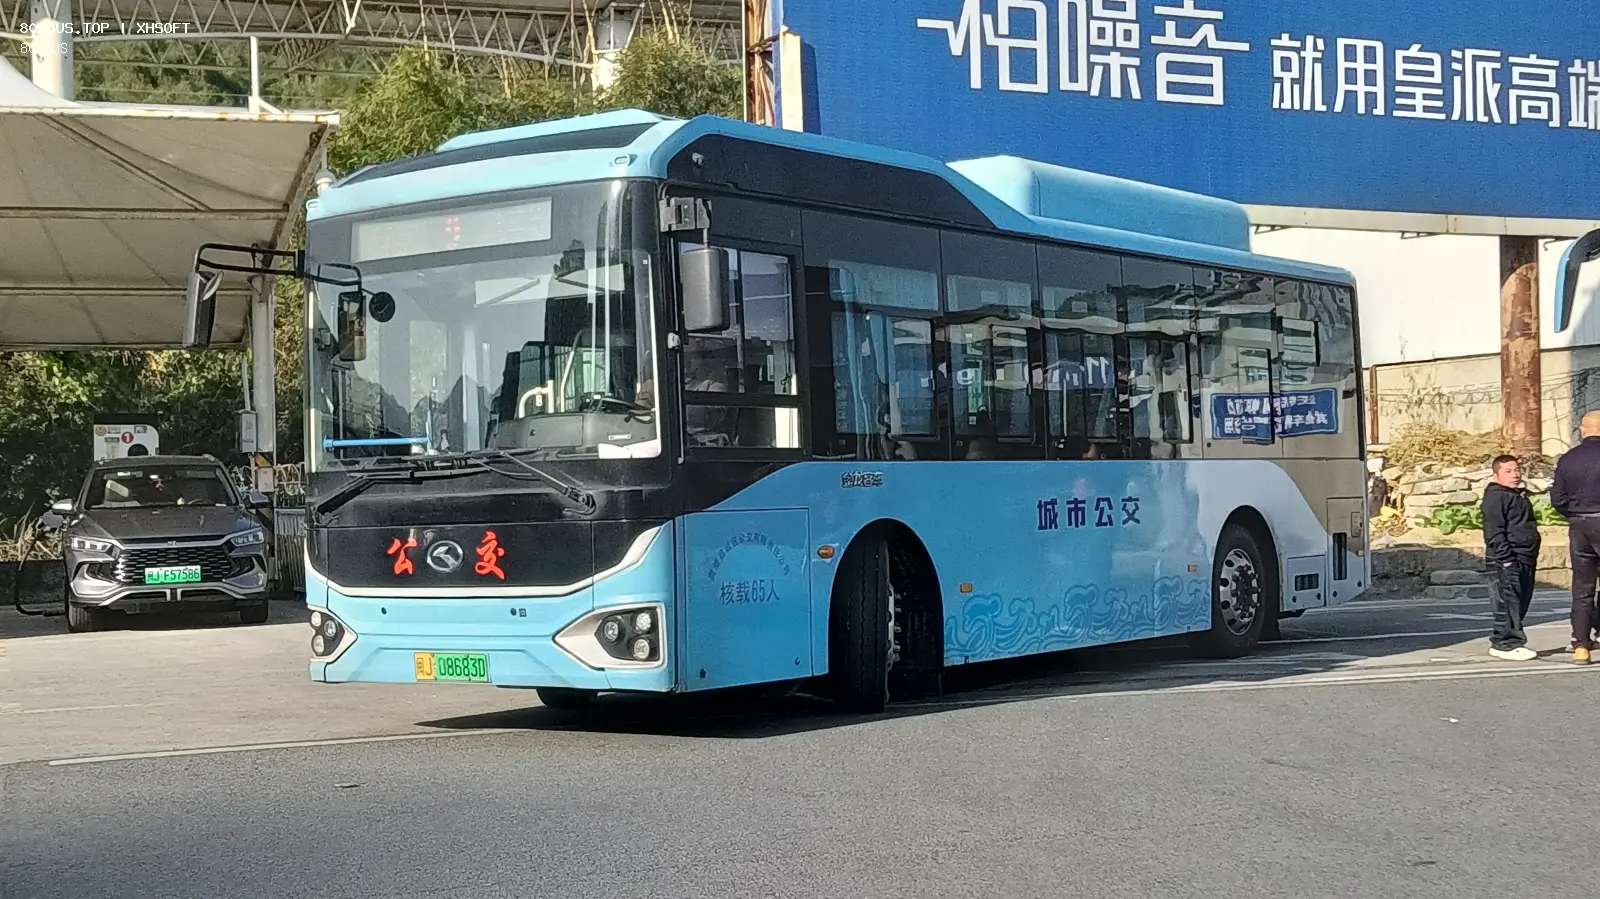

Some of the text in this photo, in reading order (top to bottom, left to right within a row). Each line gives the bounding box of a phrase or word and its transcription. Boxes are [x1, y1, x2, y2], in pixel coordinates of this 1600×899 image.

[1270, 34, 1600, 130] 就用皇派高端
[1036, 497, 1141, 531] 城市公交
[720, 578, 780, 605] 核载65人
